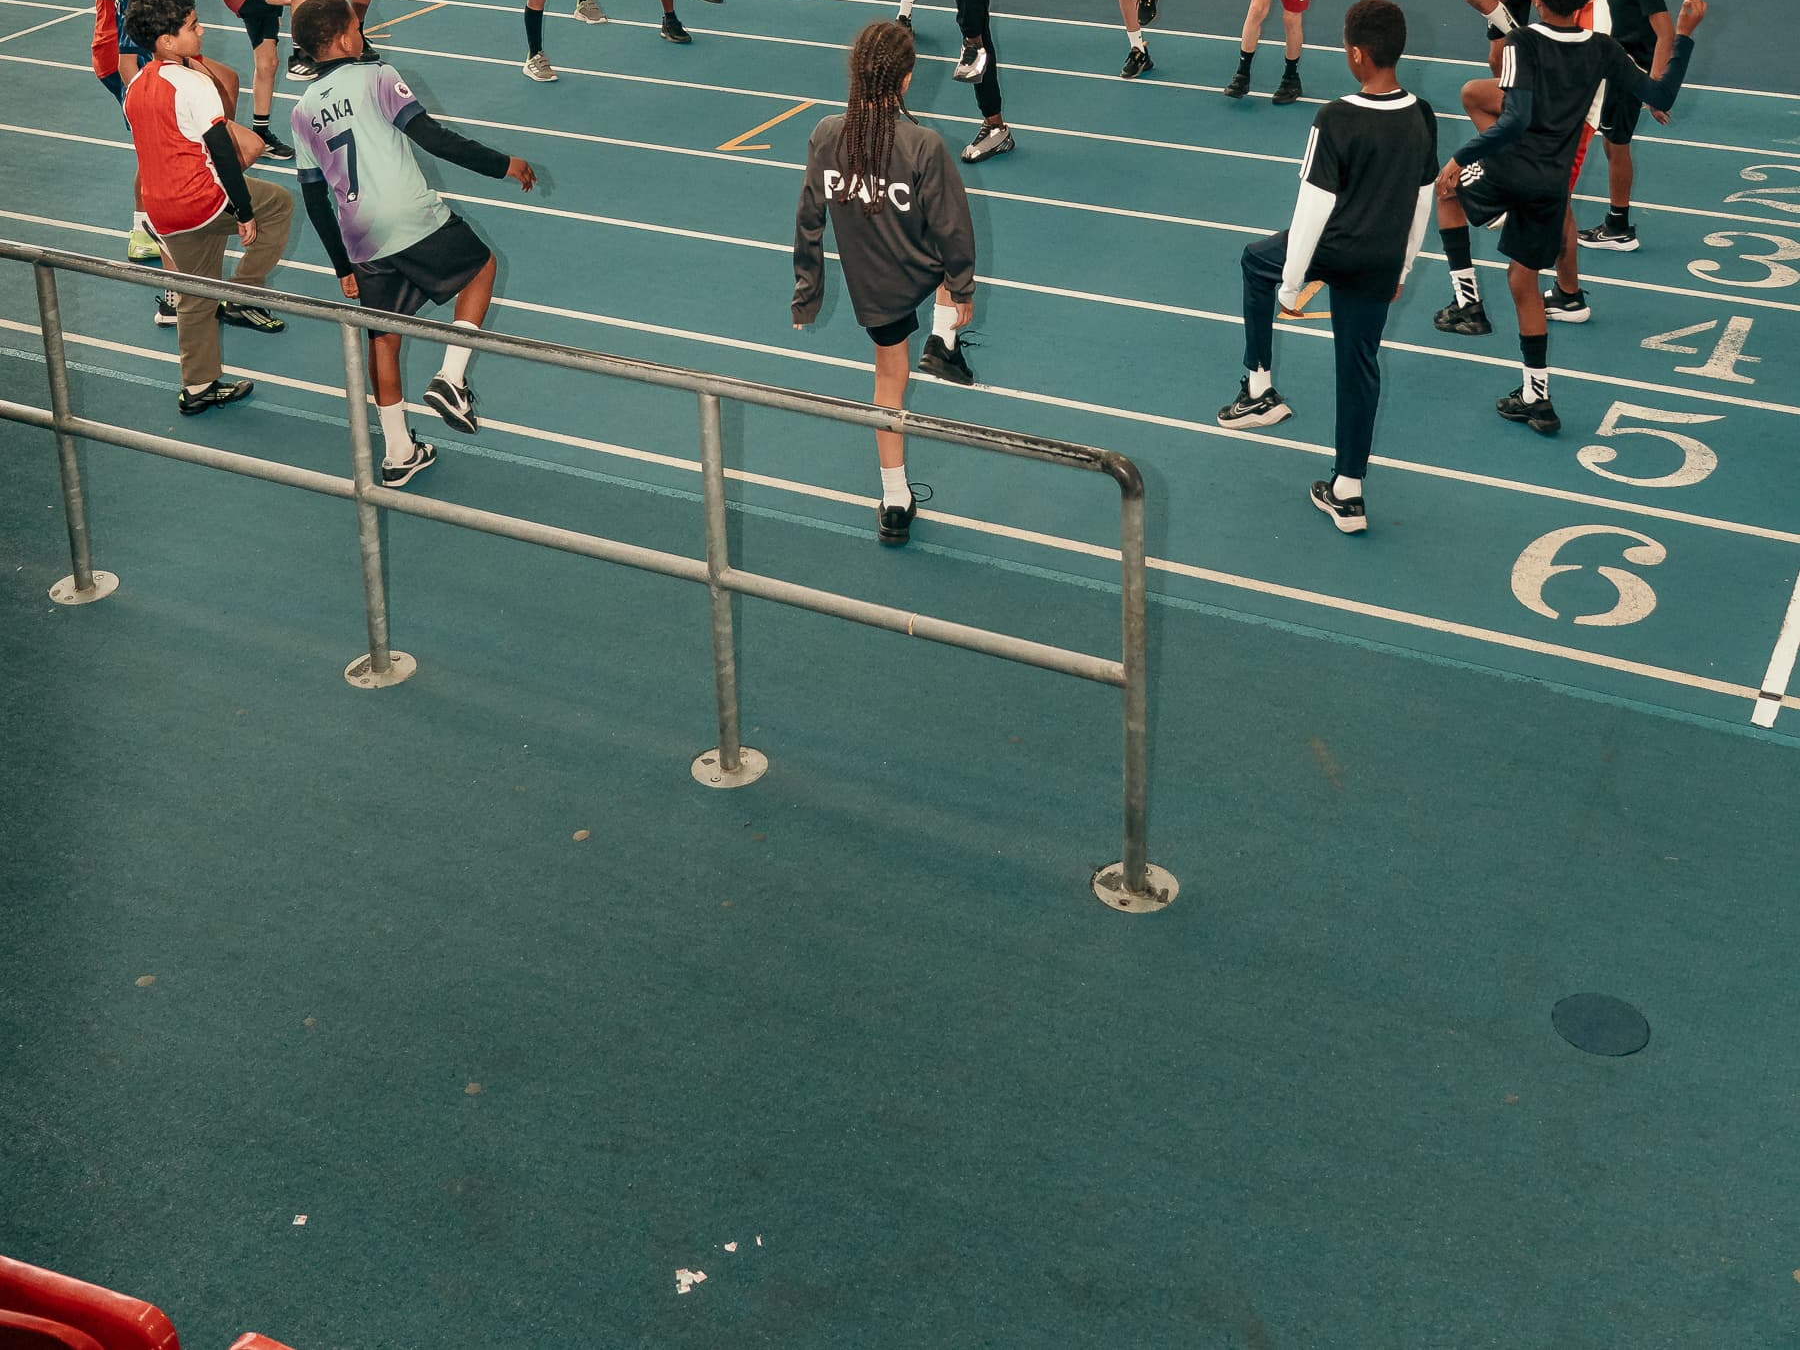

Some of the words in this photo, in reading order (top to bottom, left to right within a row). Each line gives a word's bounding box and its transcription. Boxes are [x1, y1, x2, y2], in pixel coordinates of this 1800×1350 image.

[311, 98, 354, 134] SAKA
[325, 128, 359, 203] 7
[1687, 231, 1800, 289] 3
[1640, 315, 1762, 385] 4
[1576, 400, 1727, 488] 5
[1510, 524, 1667, 627] 6
